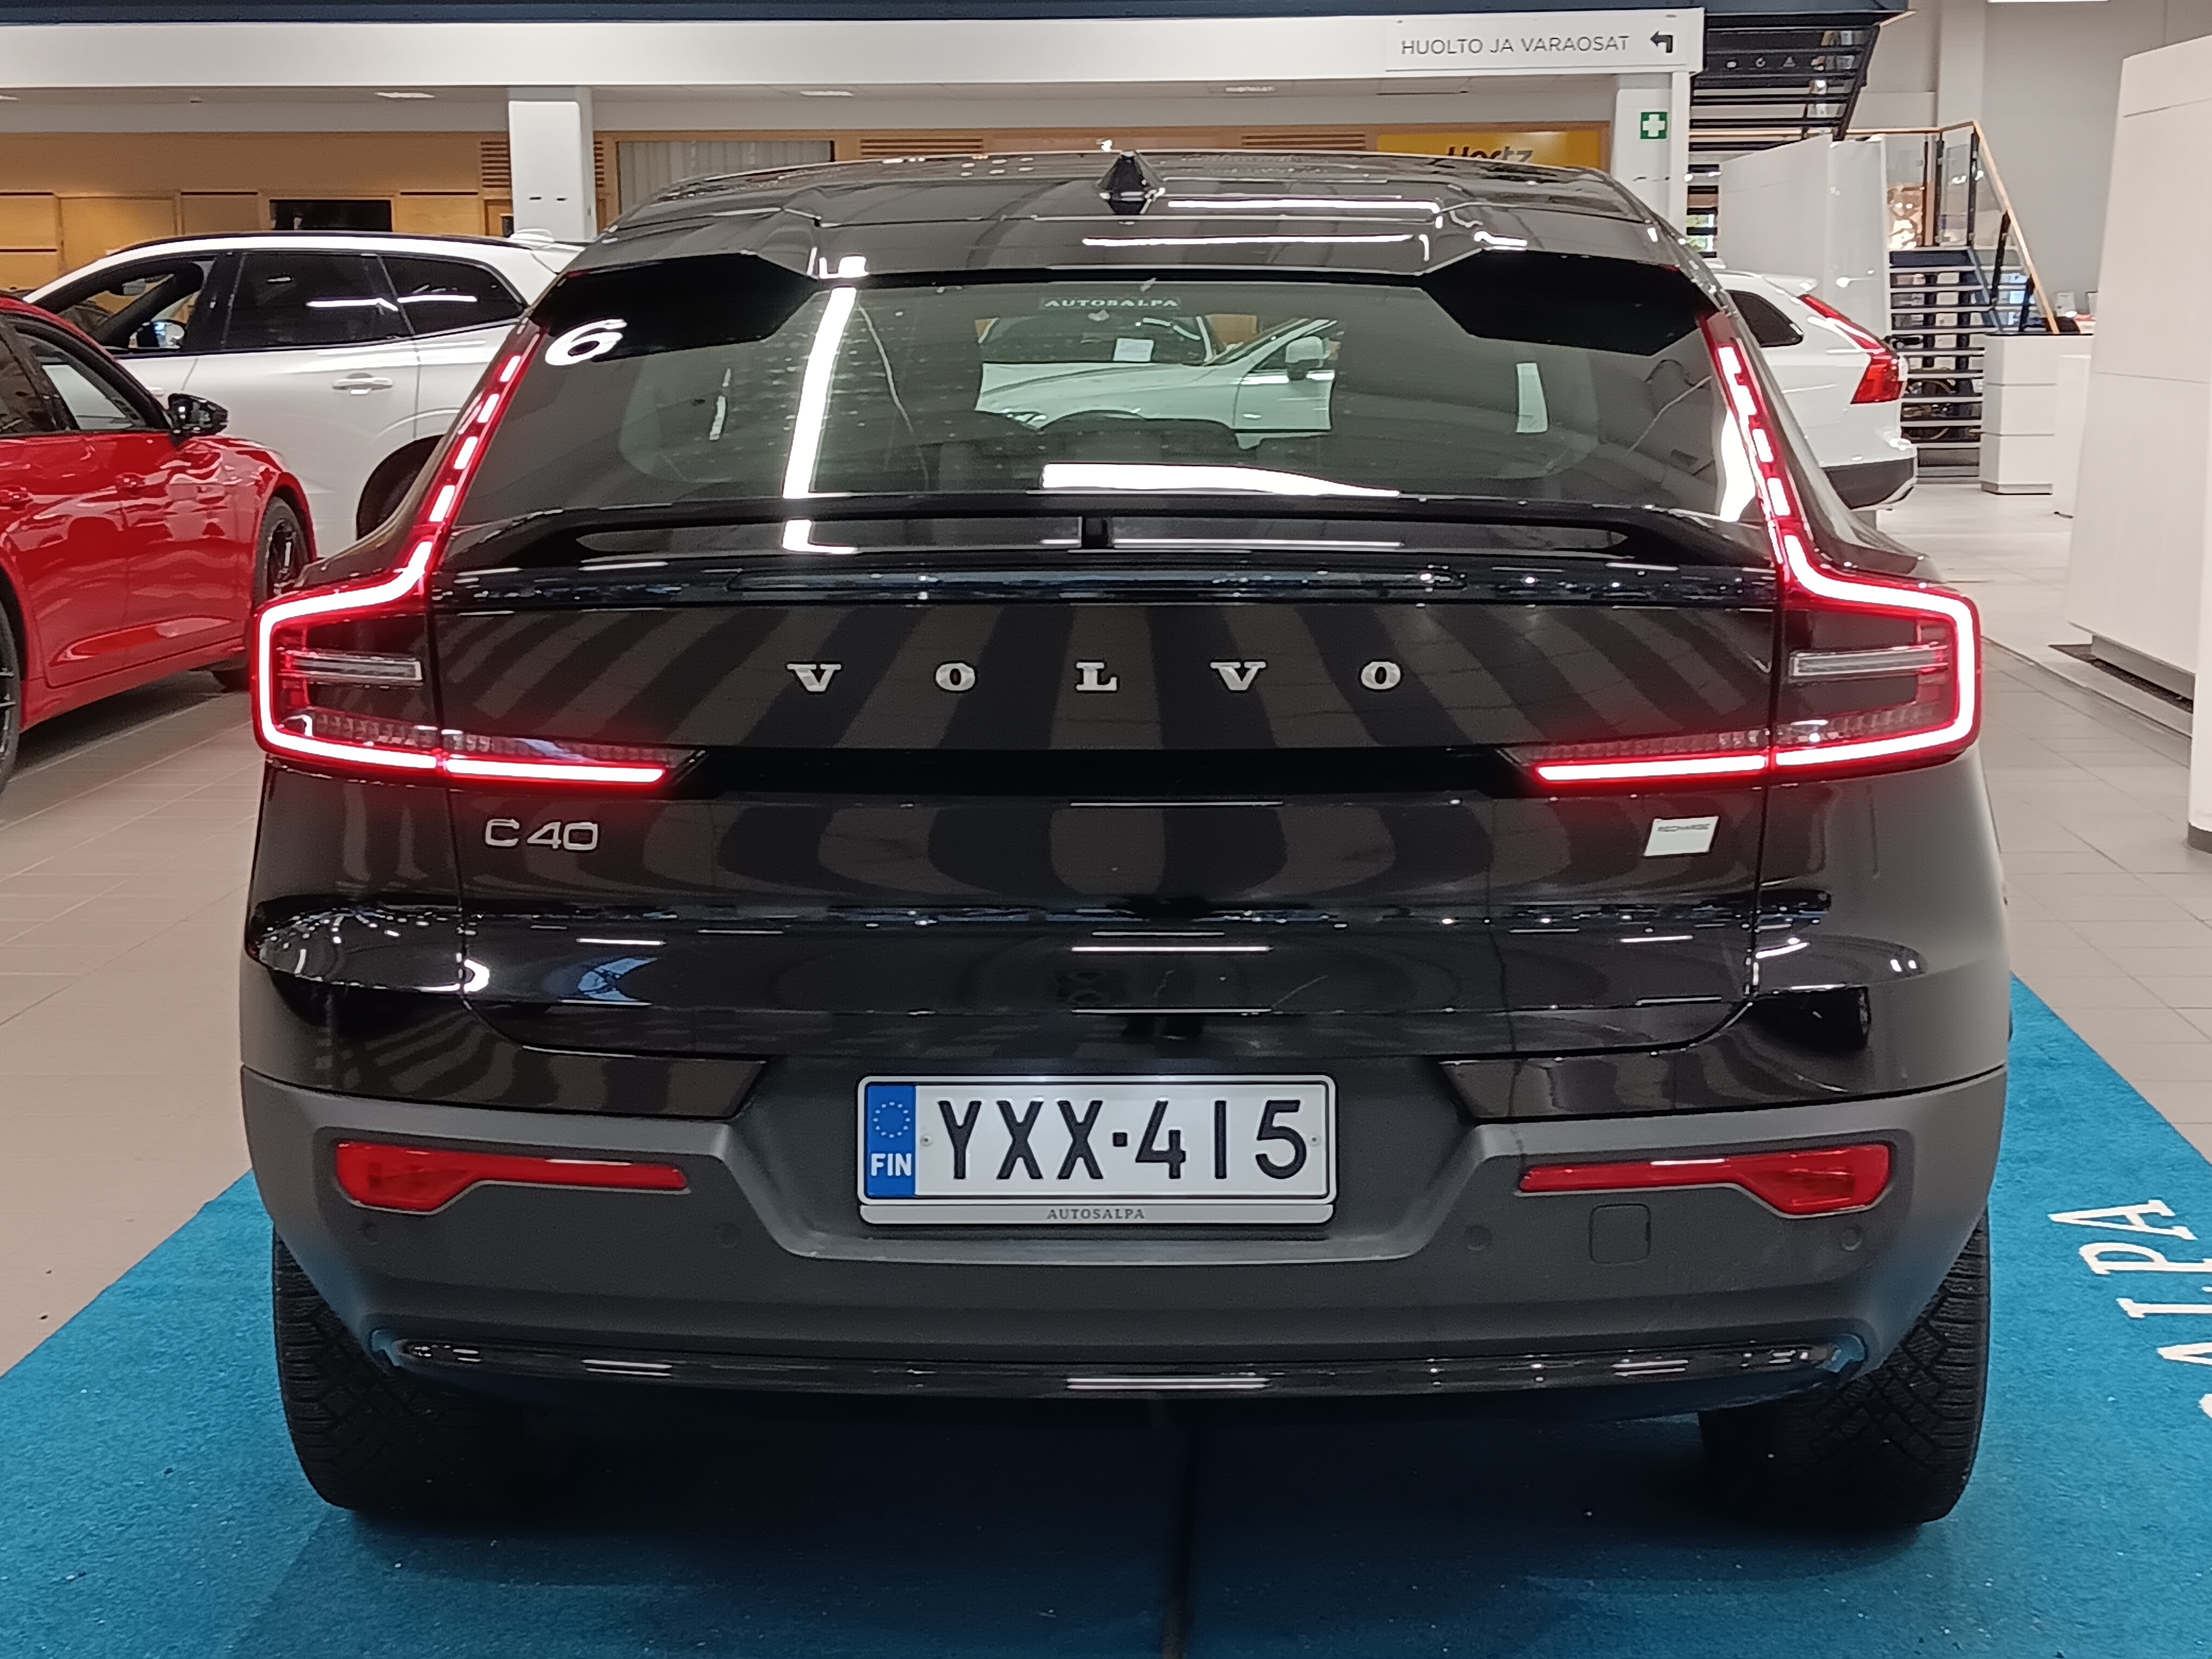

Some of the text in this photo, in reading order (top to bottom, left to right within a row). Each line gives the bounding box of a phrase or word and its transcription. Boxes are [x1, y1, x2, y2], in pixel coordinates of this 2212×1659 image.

[1401, 35, 1630, 54] HUOLTO JA VARAOSAT
[787, 660, 1403, 692] VOLVO
[485, 819, 599, 851] C40
[871, 1153, 912, 1176] FIN
[1046, 1208, 1145, 1219] AUTOSALPA
